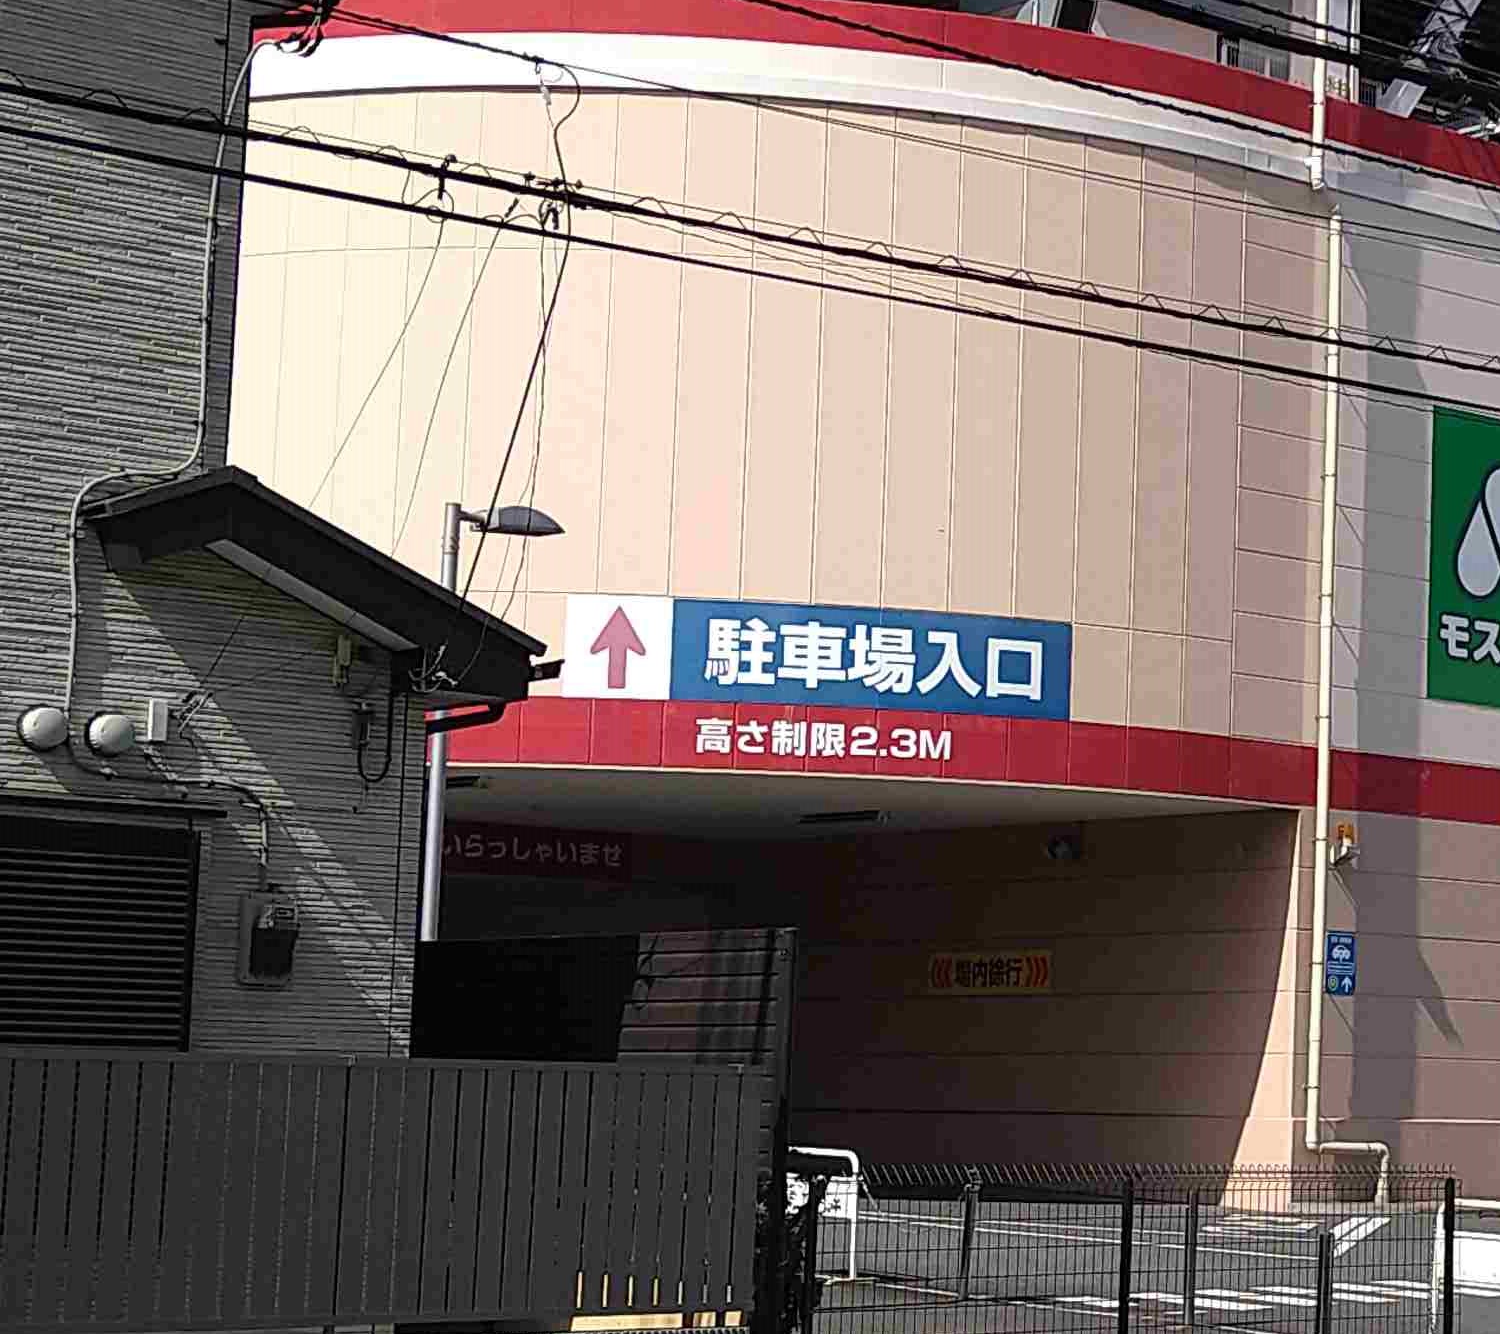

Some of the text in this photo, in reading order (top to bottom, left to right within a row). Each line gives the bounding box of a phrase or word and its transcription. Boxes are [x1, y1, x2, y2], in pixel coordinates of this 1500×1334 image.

[703, 616, 1045, 703] 駐車場入口
[695, 717, 952, 761] 高さ制限2.3M
[444, 834, 625, 868] いらっしゃいませ
